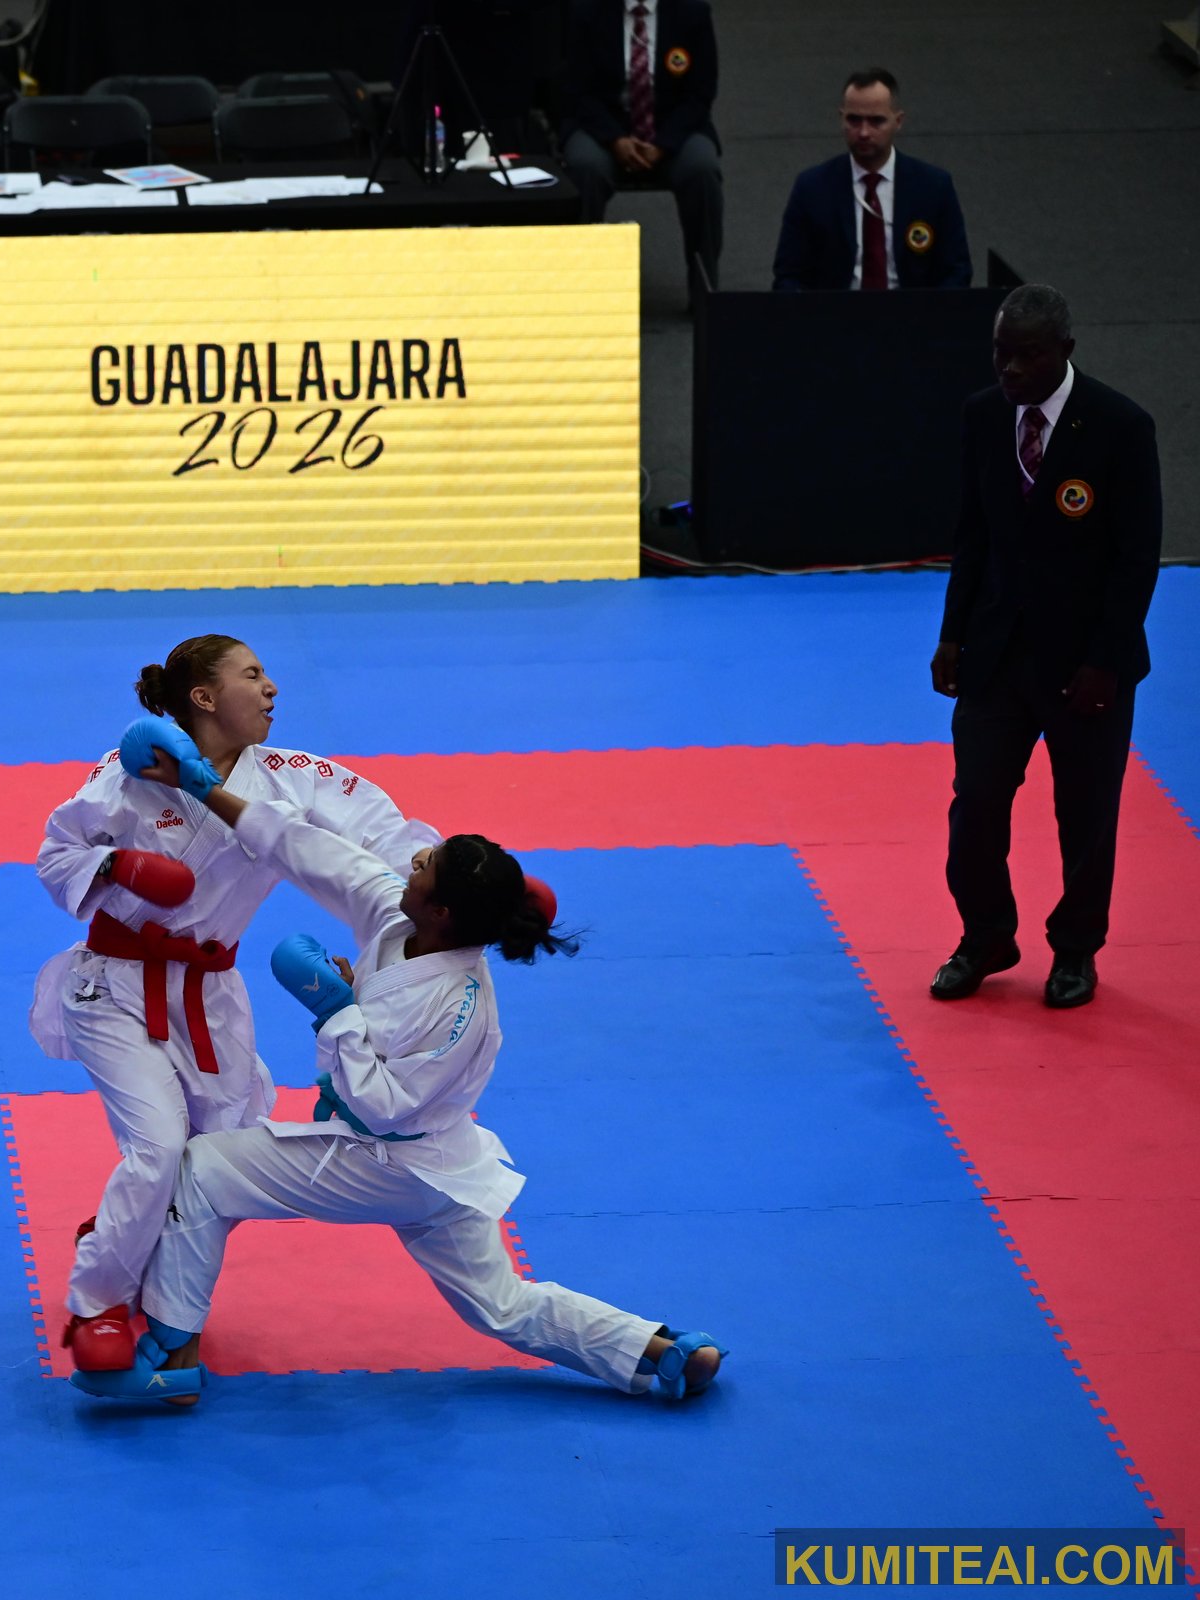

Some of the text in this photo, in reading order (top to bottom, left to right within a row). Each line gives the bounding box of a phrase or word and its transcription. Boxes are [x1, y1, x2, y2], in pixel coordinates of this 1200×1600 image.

[90, 338, 467, 406] GUADALAJARA
[173, 405, 385, 476] 2026
[343, 775, 359, 796] Daedo
[156, 815, 184, 829] Daedo
[438, 973, 481, 1052] Arawa
